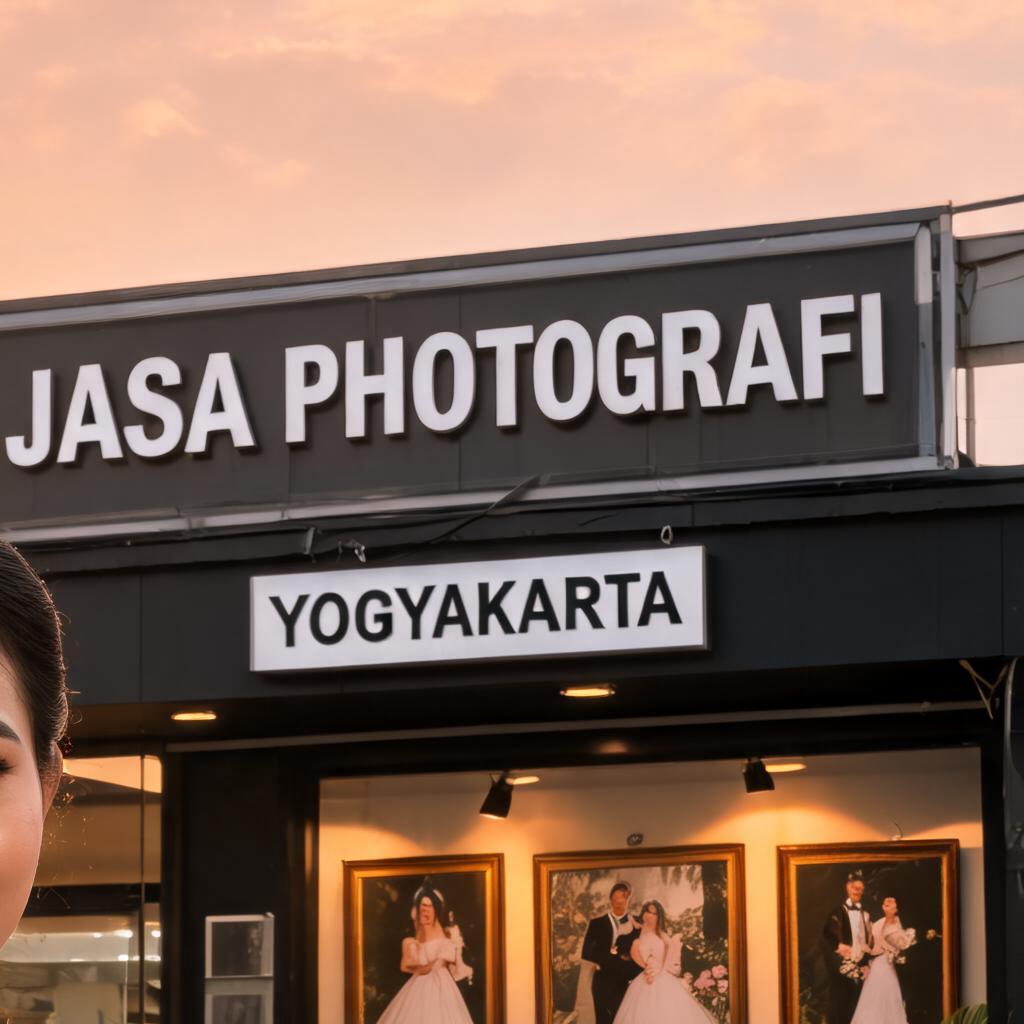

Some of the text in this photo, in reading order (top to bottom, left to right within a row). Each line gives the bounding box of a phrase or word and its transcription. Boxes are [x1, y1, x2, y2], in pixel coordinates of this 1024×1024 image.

[5, 352, 256, 468] JASA
[285, 292, 885, 445] PHOTOGRAFI
[269, 571, 682, 648] YOGYAKARTA
